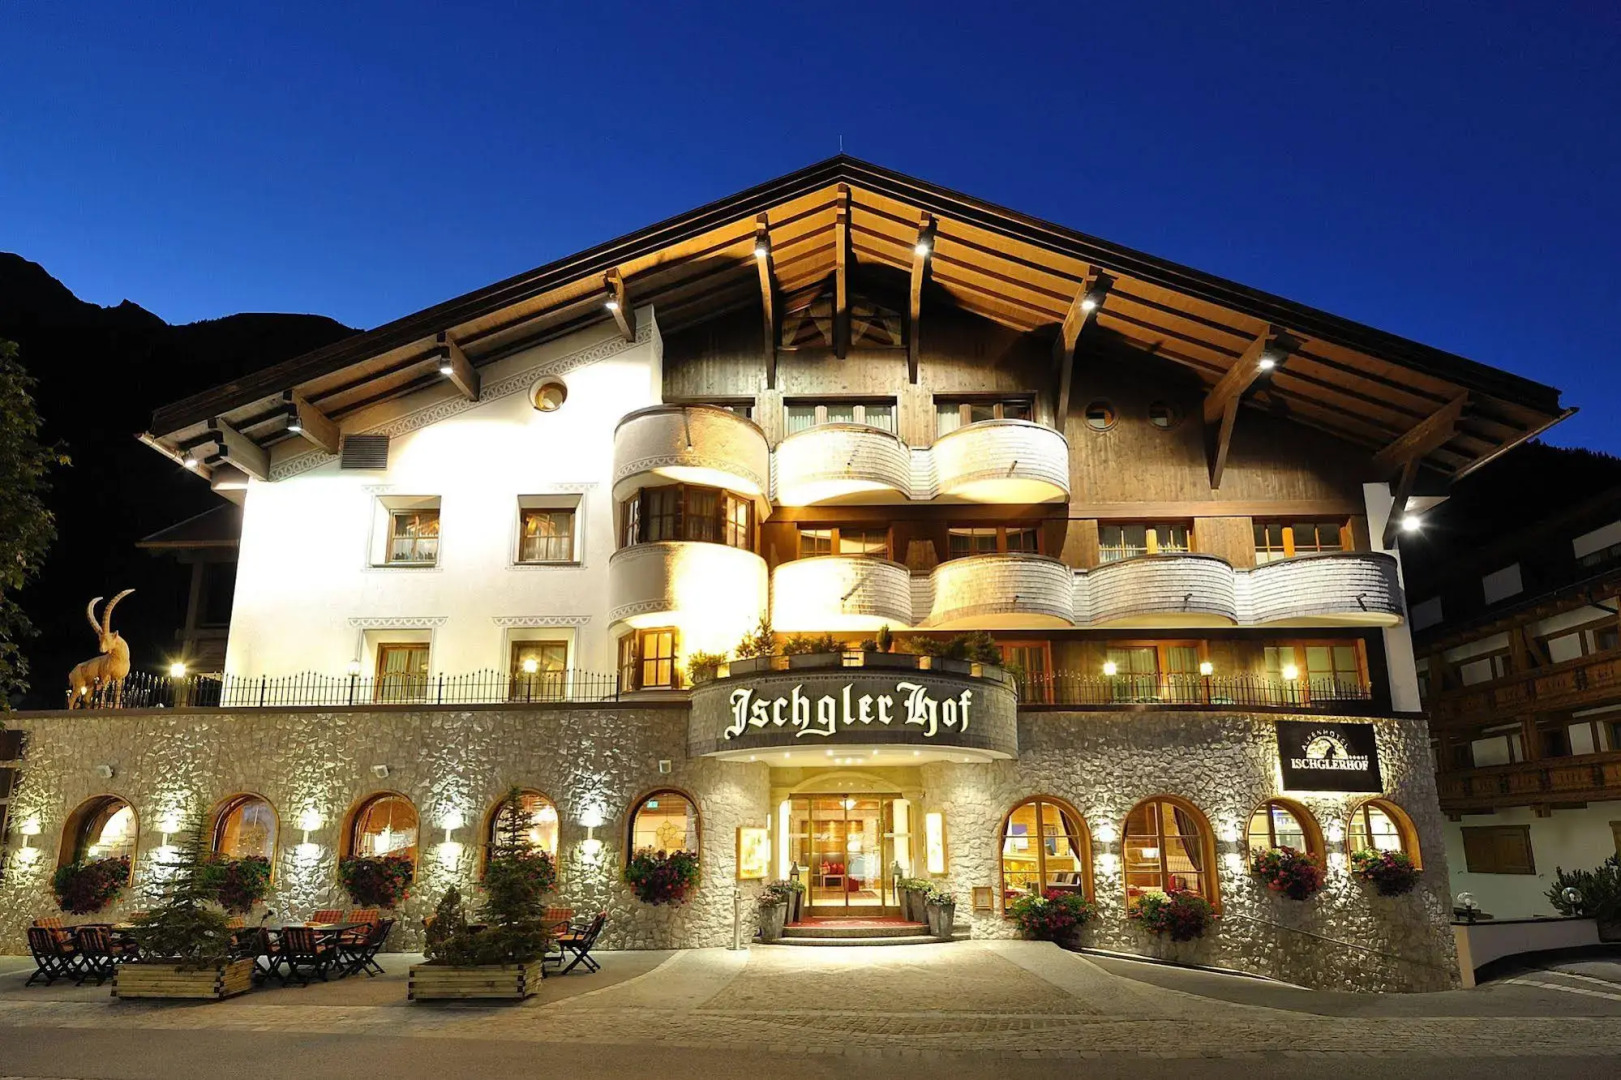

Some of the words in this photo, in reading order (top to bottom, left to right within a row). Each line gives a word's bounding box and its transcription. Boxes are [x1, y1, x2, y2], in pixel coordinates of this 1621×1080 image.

[896, 682, 973, 737] Hof
[1301, 729, 1348, 751] ALPENHOTEL
[1291, 758, 1369, 771] ISCHGLERHOF
